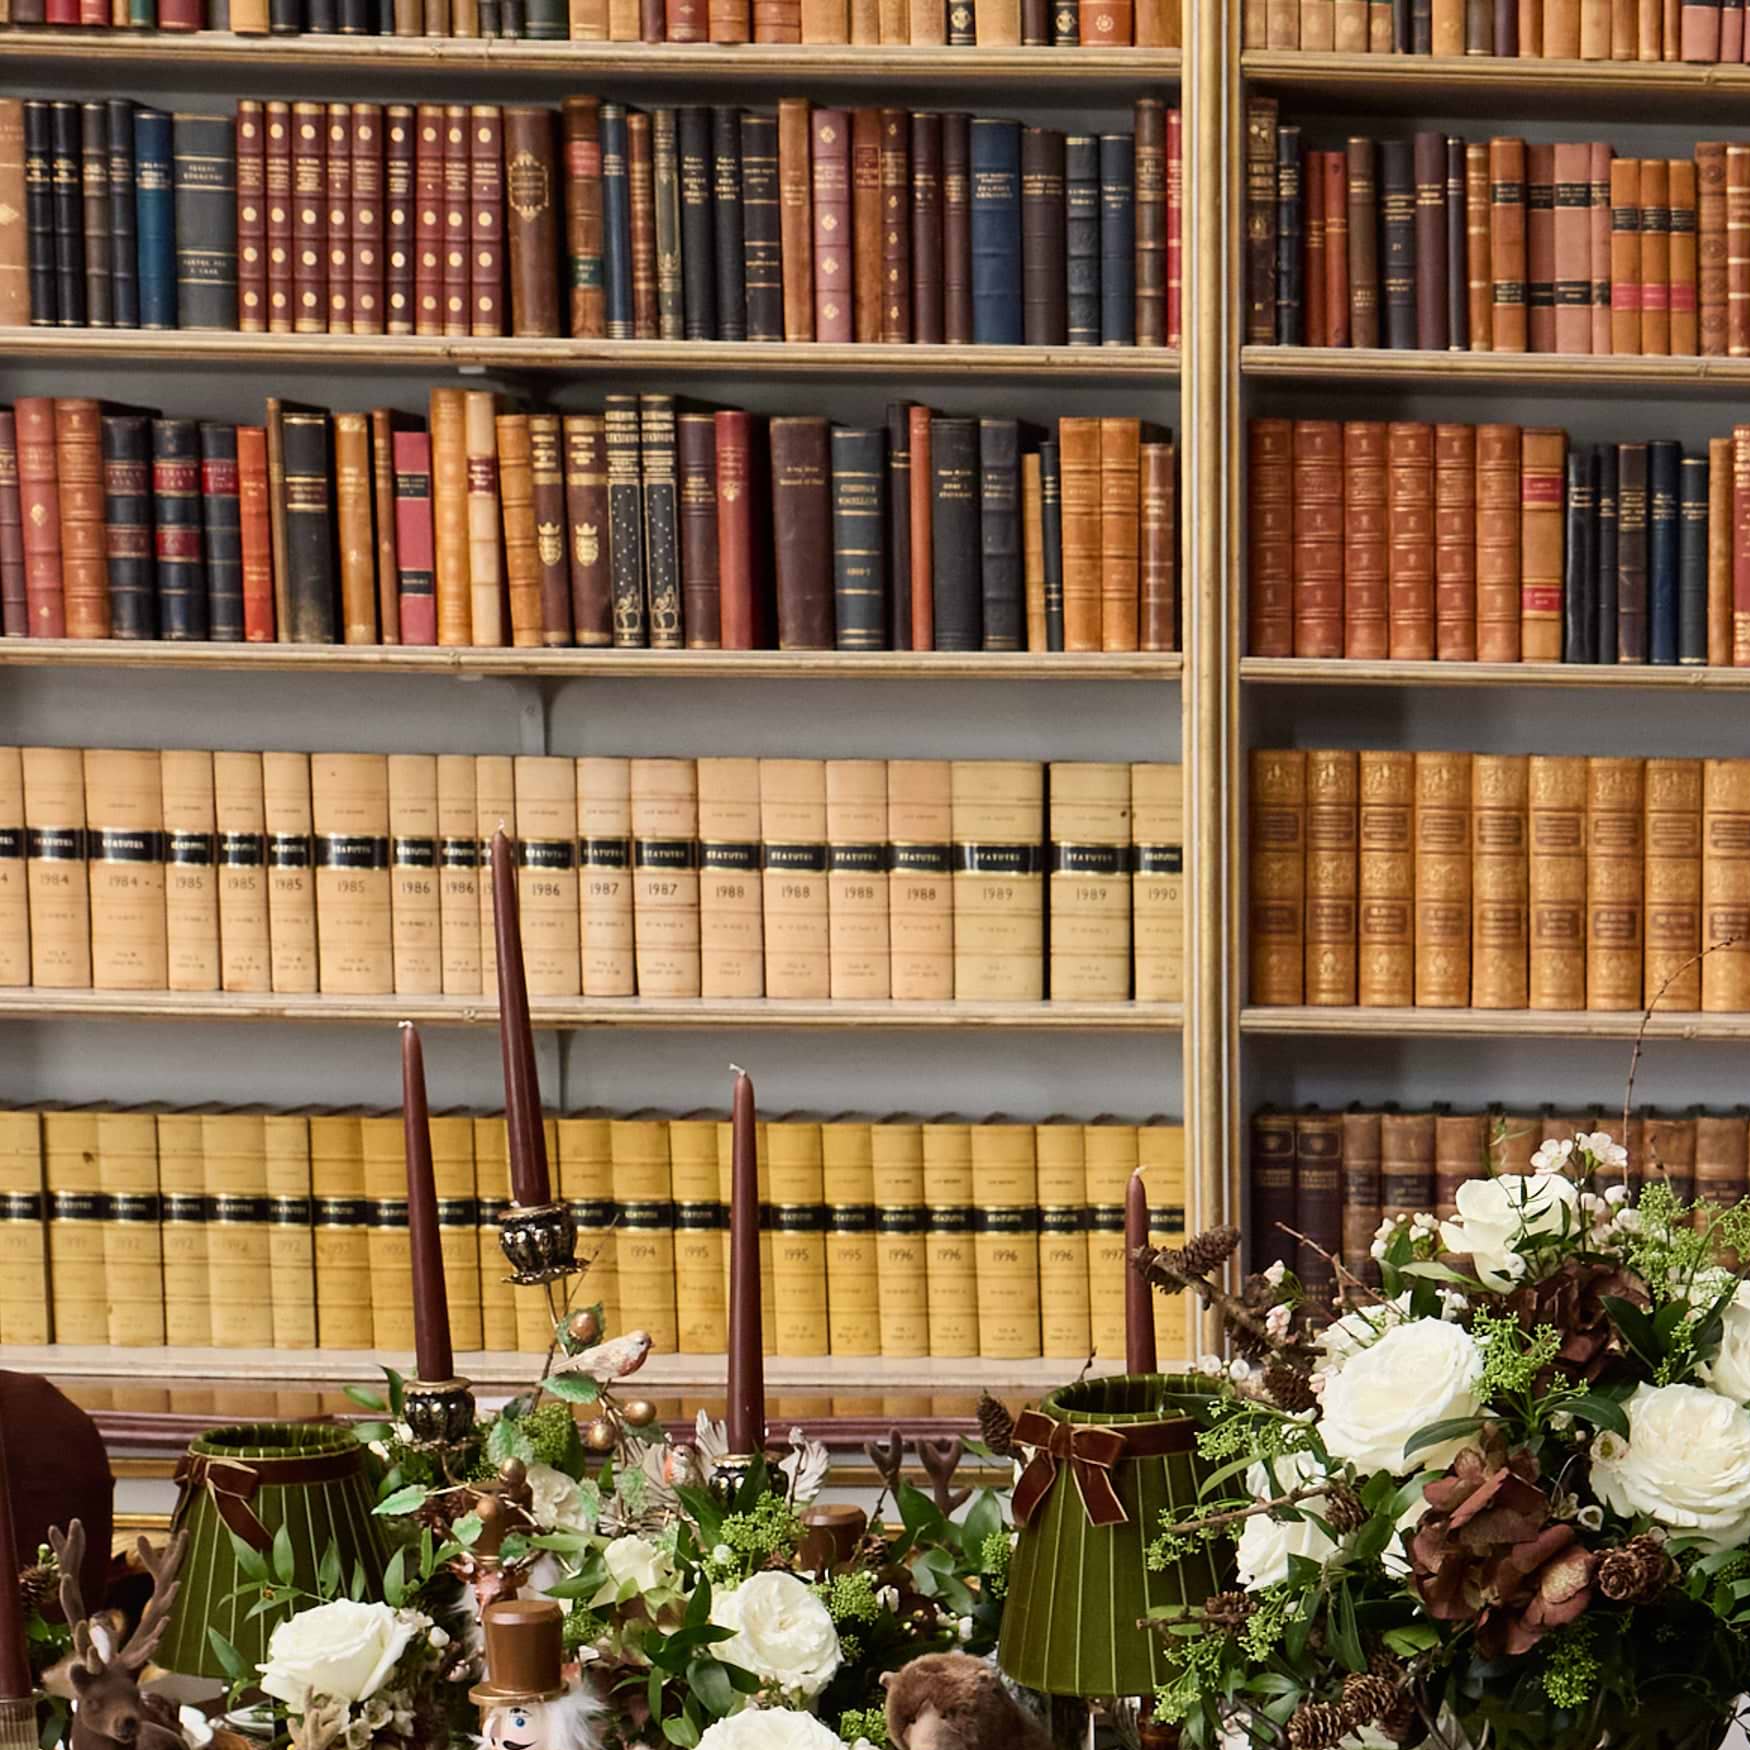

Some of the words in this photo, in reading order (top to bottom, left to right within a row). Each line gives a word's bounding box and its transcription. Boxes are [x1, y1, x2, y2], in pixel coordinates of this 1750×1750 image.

[40, 873, 69, 886] 1984
[109, 875, 138, 887] 1984
[175, 877, 203, 890] 1985
[227, 877, 255, 890] 1985
[274, 878, 302, 891] 1985
[337, 881, 365, 893] 1985
[402, 881, 430, 894] 1986
[446, 881, 474, 894] 1986
[532, 884, 560, 897] 1986
[590, 882, 619, 896] 1987
[648, 883, 677, 896] 1987
[715, 885, 744, 898] 1988
[781, 885, 810, 898] 1988
[844, 886, 873, 898] 1988
[907, 888, 936, 900] 1988
[983, 888, 1013, 900] 1989
[1076, 888, 1106, 900] 1989
[1148, 888, 1177, 900] 1990
